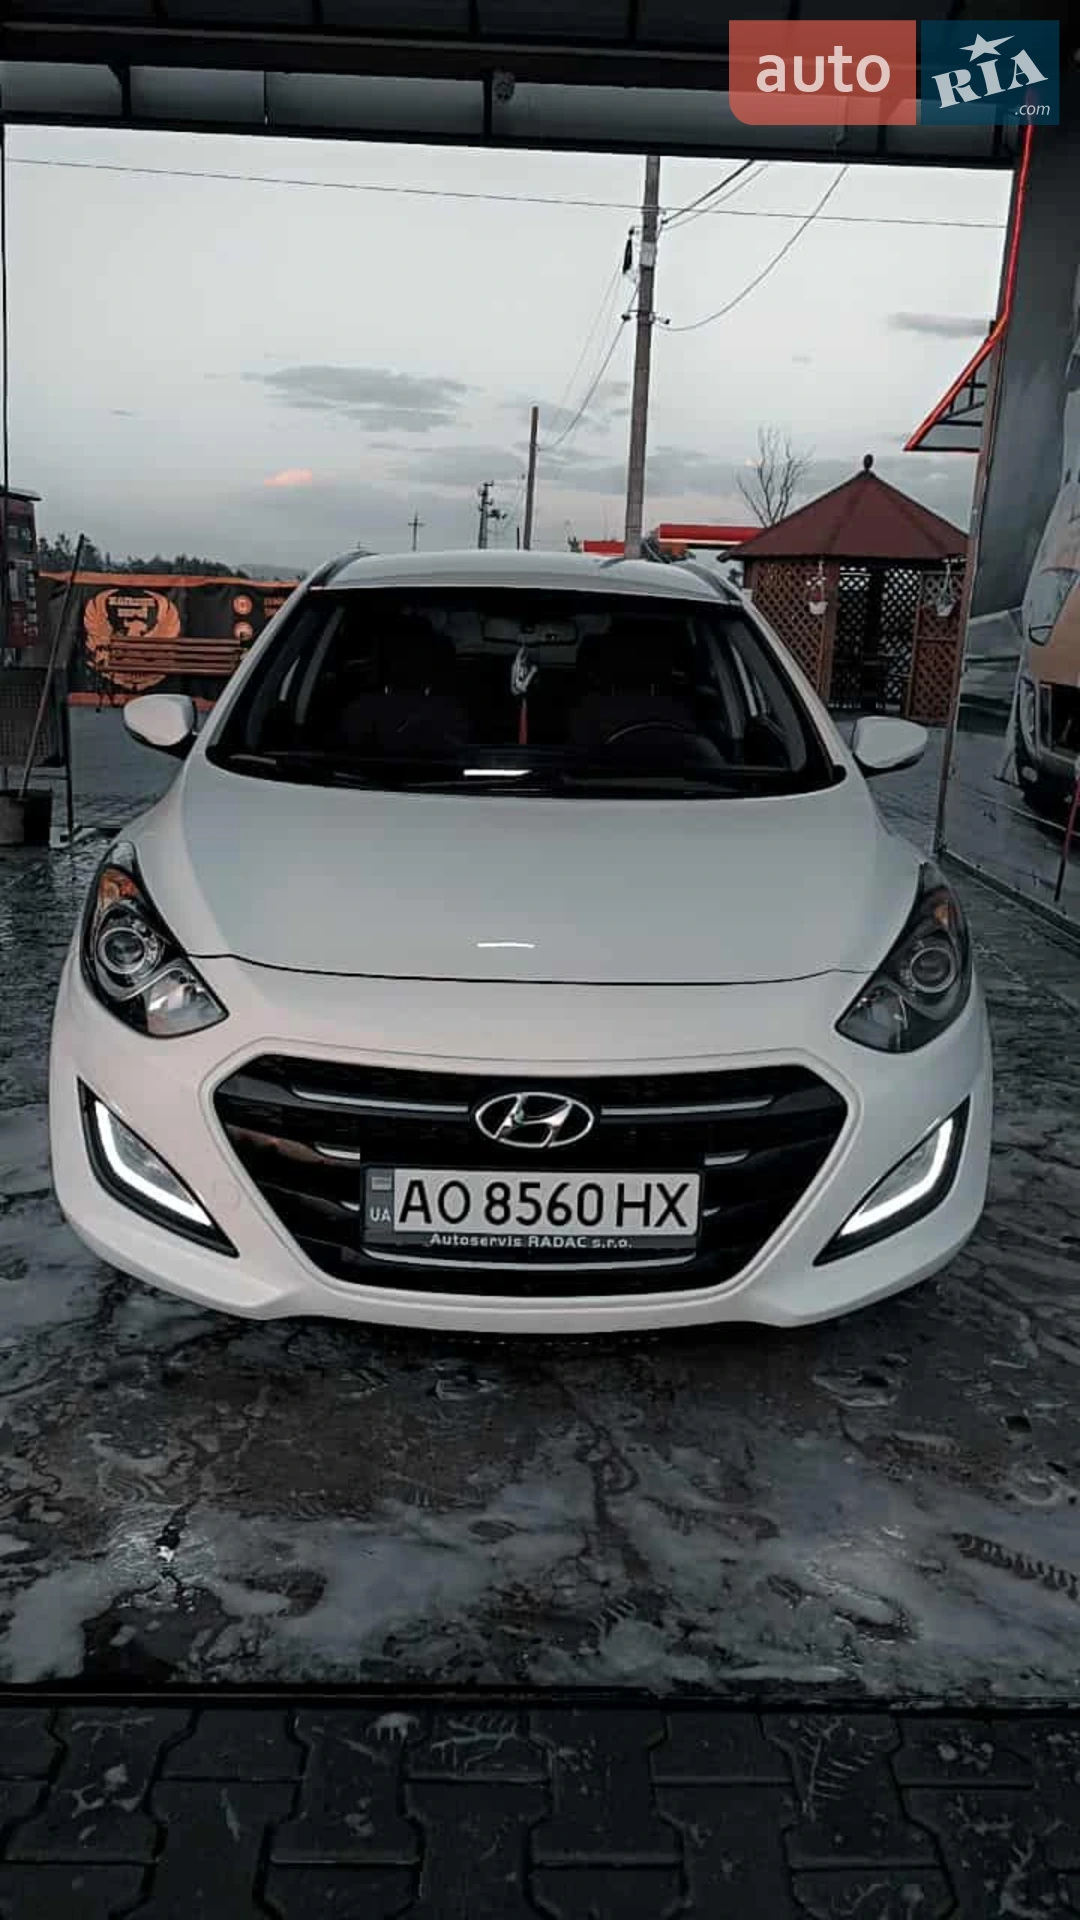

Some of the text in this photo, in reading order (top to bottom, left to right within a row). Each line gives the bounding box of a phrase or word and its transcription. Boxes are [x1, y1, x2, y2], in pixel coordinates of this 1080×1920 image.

[398, 1179, 690, 1228] AO 8560 HX
[369, 1207, 391, 1223] UA
[430, 1233, 632, 1249] Autoservis RADAC s.r.o.
